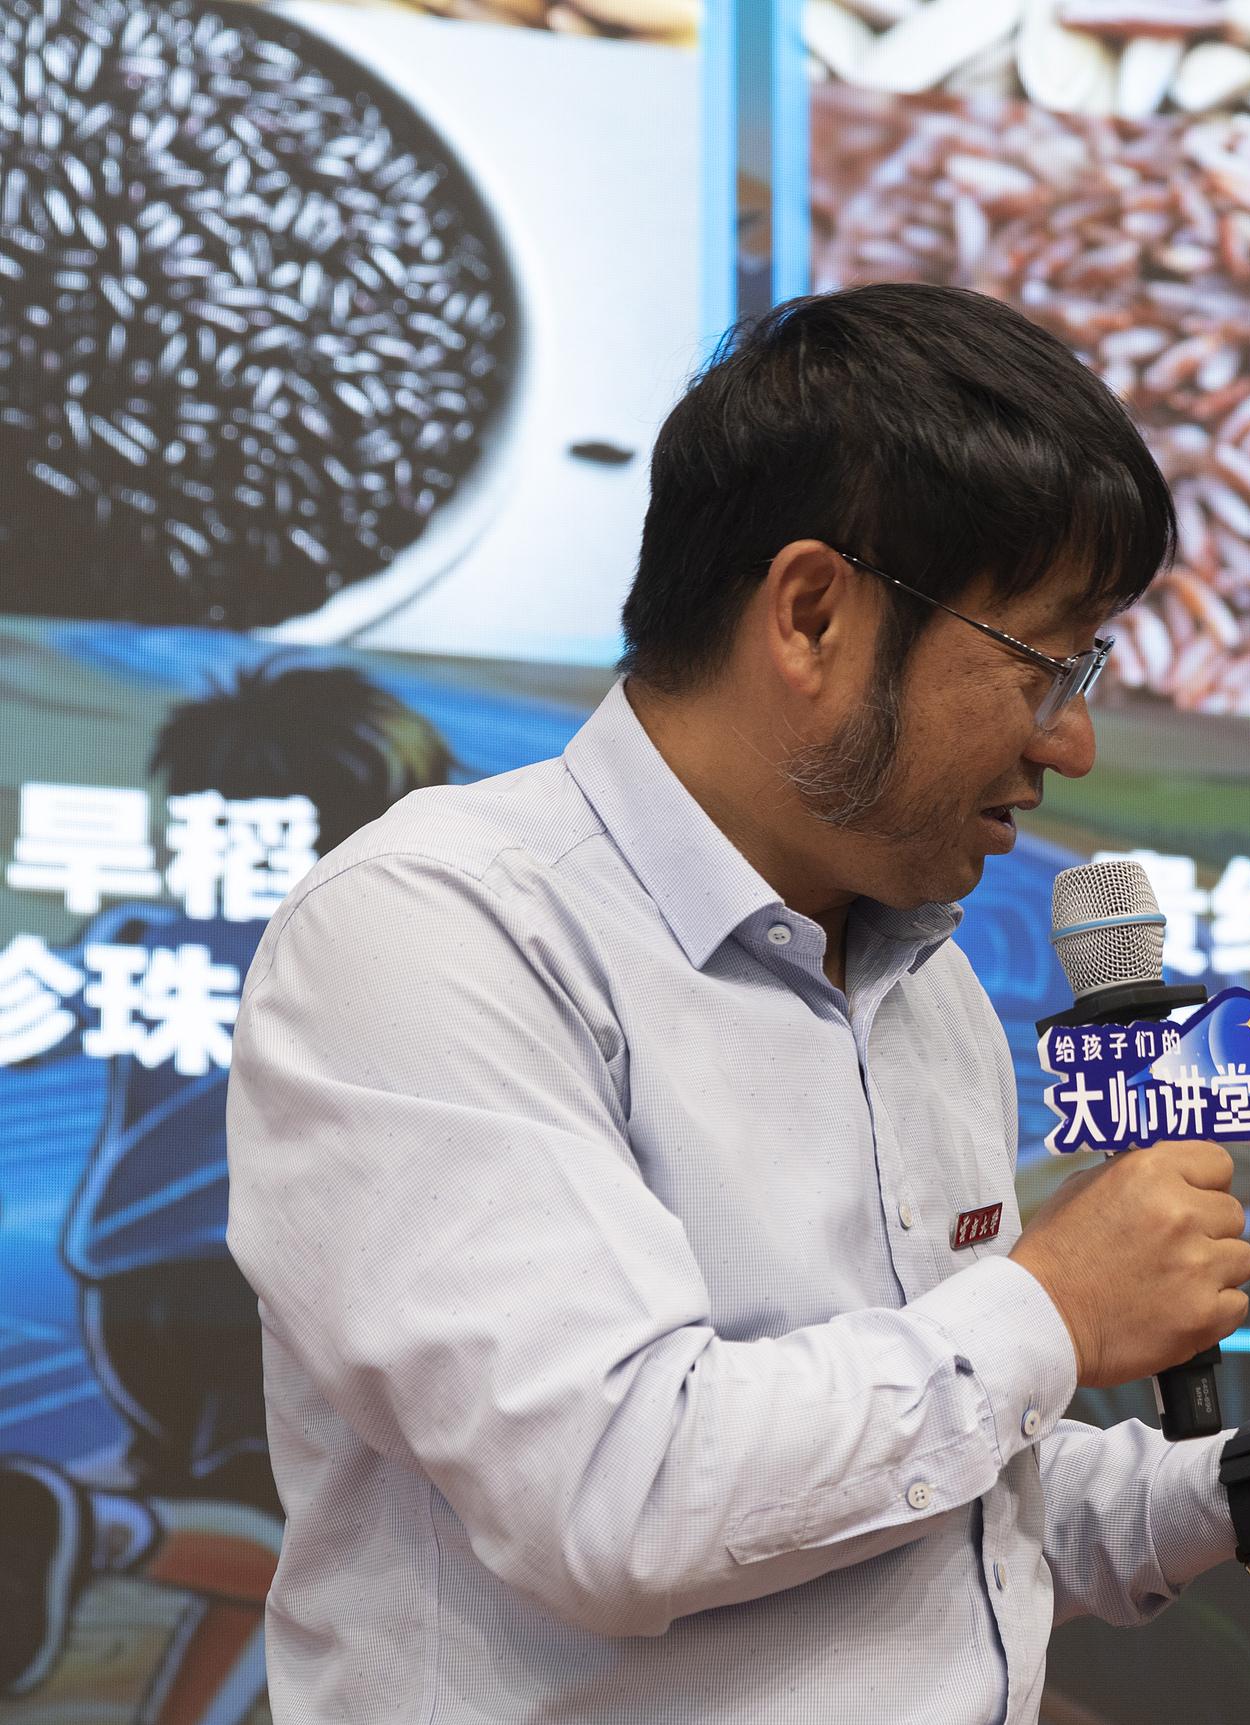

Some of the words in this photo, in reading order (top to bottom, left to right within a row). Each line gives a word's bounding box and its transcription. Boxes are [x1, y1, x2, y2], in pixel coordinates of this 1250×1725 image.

[6, 780, 320, 922] 旱稻
[1055, 1028, 1182, 1063] 给孩子们的
